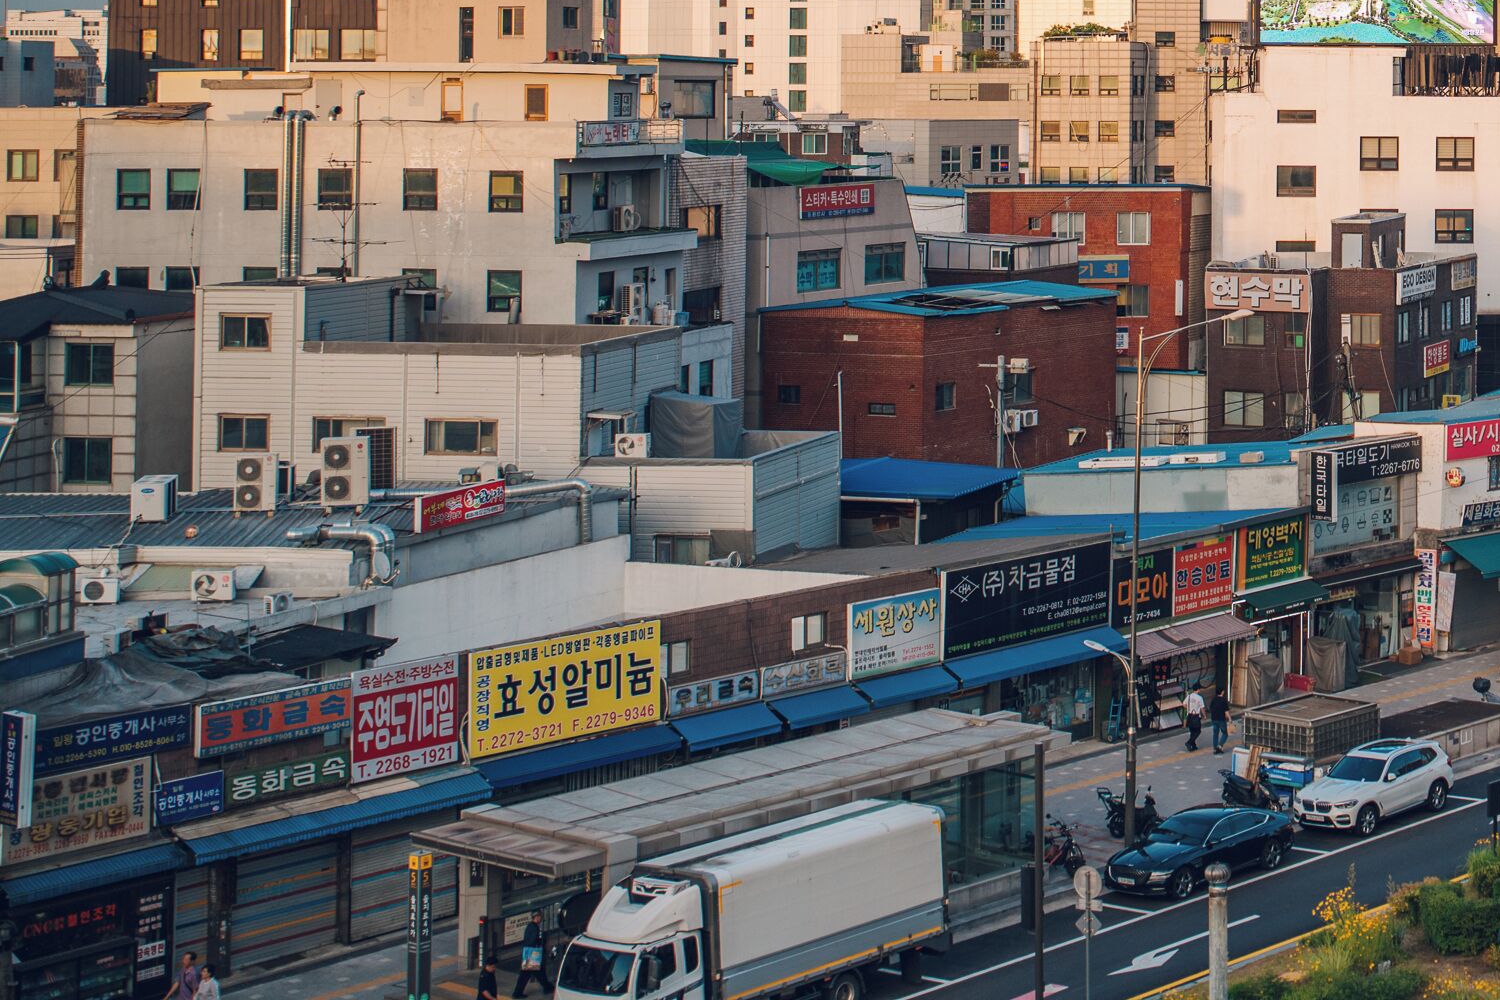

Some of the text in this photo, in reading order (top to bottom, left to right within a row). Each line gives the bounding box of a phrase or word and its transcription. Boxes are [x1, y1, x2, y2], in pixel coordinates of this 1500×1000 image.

[806, 191, 858, 207] 스티커·특수인쇄
[1402, 266, 1435, 288] ECO DESIGN
[1210, 276, 1303, 309] 현수막
[1337, 444, 1389, 468] 국타일도기
[1391, 442, 1410, 450] HANKOOK
[1372, 458, 1420, 476] T:2267-6776
[1316, 455, 1327, 512] 한국타일
[1248, 521, 1302, 549] 대영벽지
[958, 583, 972, 595] CHA
[982, 570, 1004, 598] (주)
[1176, 560, 1230, 590] 한승안료
[854, 598, 937, 637] 세원상사
[1054, 601, 1107, 619] cha0812@empal.com
[1123, 609, 1160, 624] T.277-7434
[494, 652, 655, 719] 효성알미늄
[476, 674, 491, 731] 공장직영
[76, 716, 156, 745] 공인중개사
[158, 714, 186, 726] 사무소
[206, 694, 346, 741] 동화금속
[357, 683, 454, 752] 주영도기타일
[477, 704, 655, 752] T.2272-3721 F.2279-9346
[376, 747, 453, 775] 2268-1921
[232, 757, 346, 800] 동화금속
[158, 790, 204, 811] 공인중개사
[31, 805, 129, 842] 광웅기업
